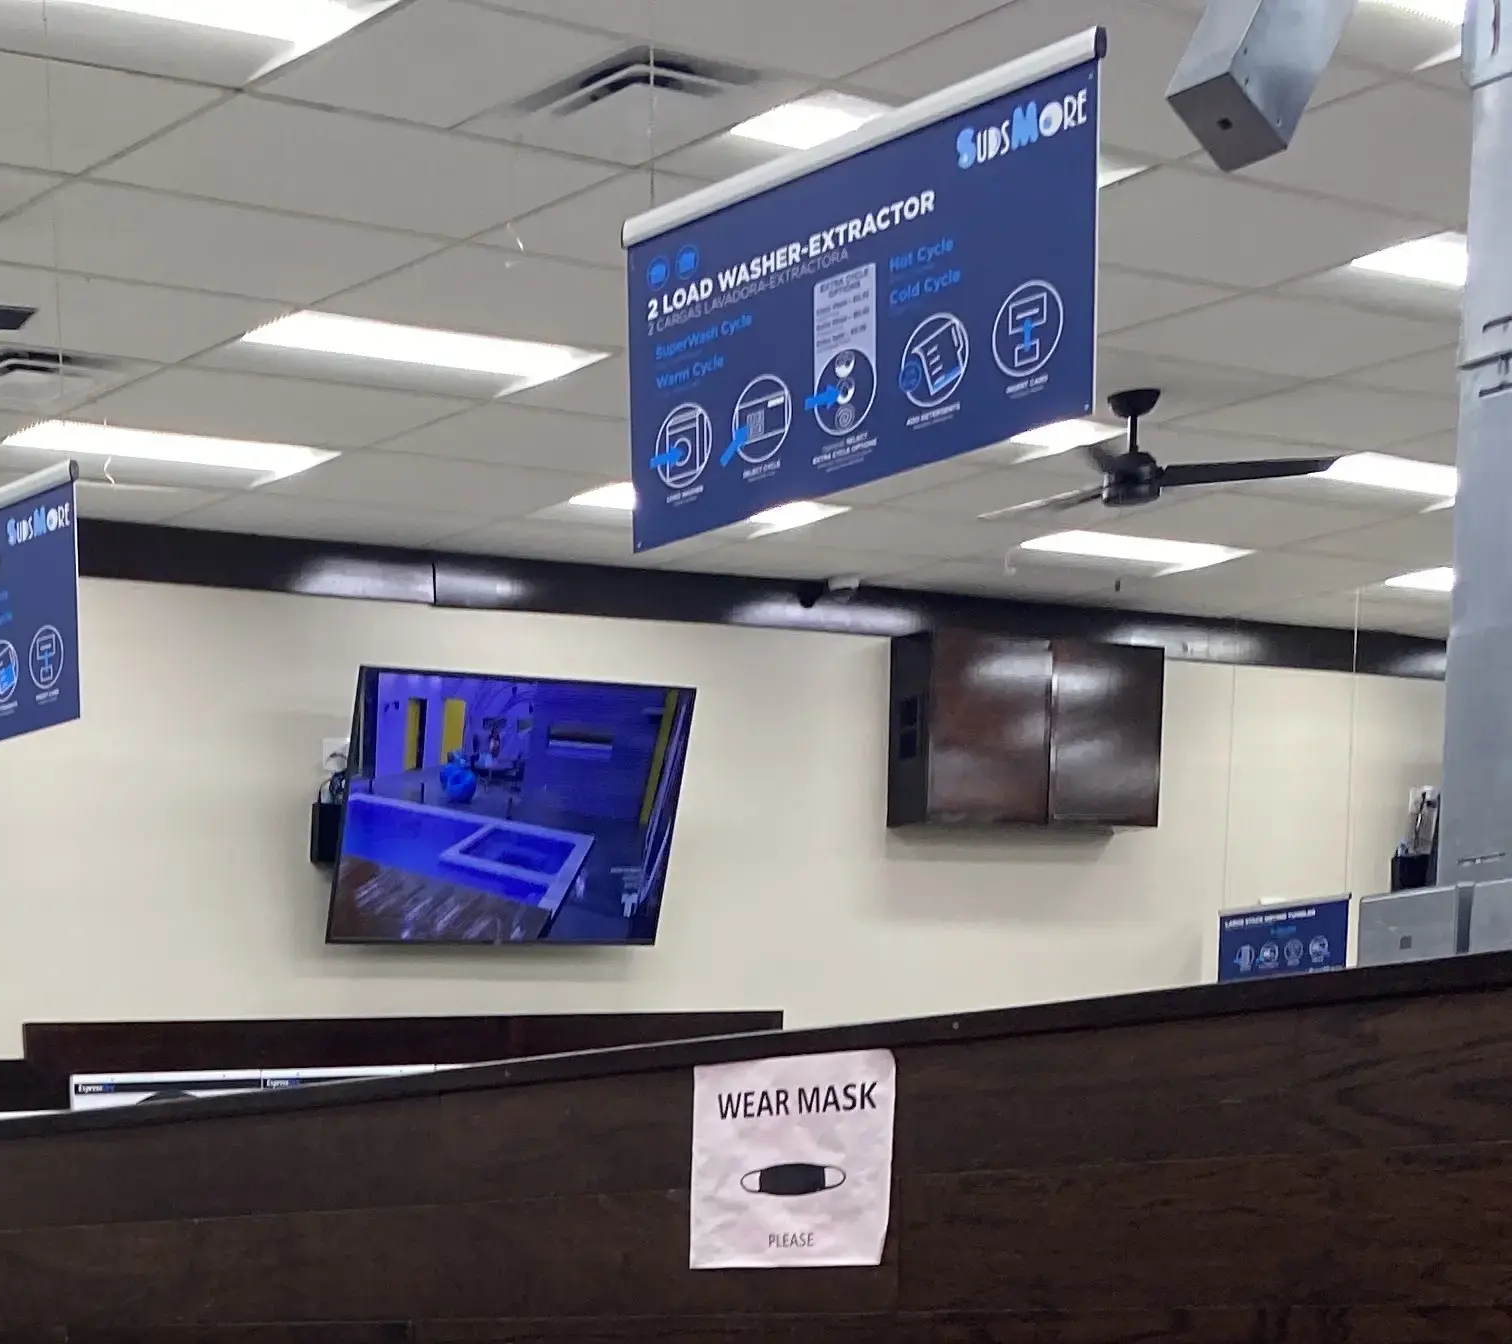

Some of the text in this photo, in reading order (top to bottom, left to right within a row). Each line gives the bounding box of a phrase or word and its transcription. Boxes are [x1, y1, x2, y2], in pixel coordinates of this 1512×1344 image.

[647, 190, 936, 322] 2 LOAD WASHER-EXTRACTOR
[889, 238, 954, 272] Hot Cycle
[647, 248, 849, 336] 2 CARGAS LAVADORA-EXTRACTORA
[890, 270, 961, 305] Cold Cycle
[655, 313, 753, 360] SuperWash Cycle
[655, 355, 724, 390] Warm Cycle
[718, 1081, 878, 1120] WEAR MASK
[768, 1232, 815, 1248] PLEASE
